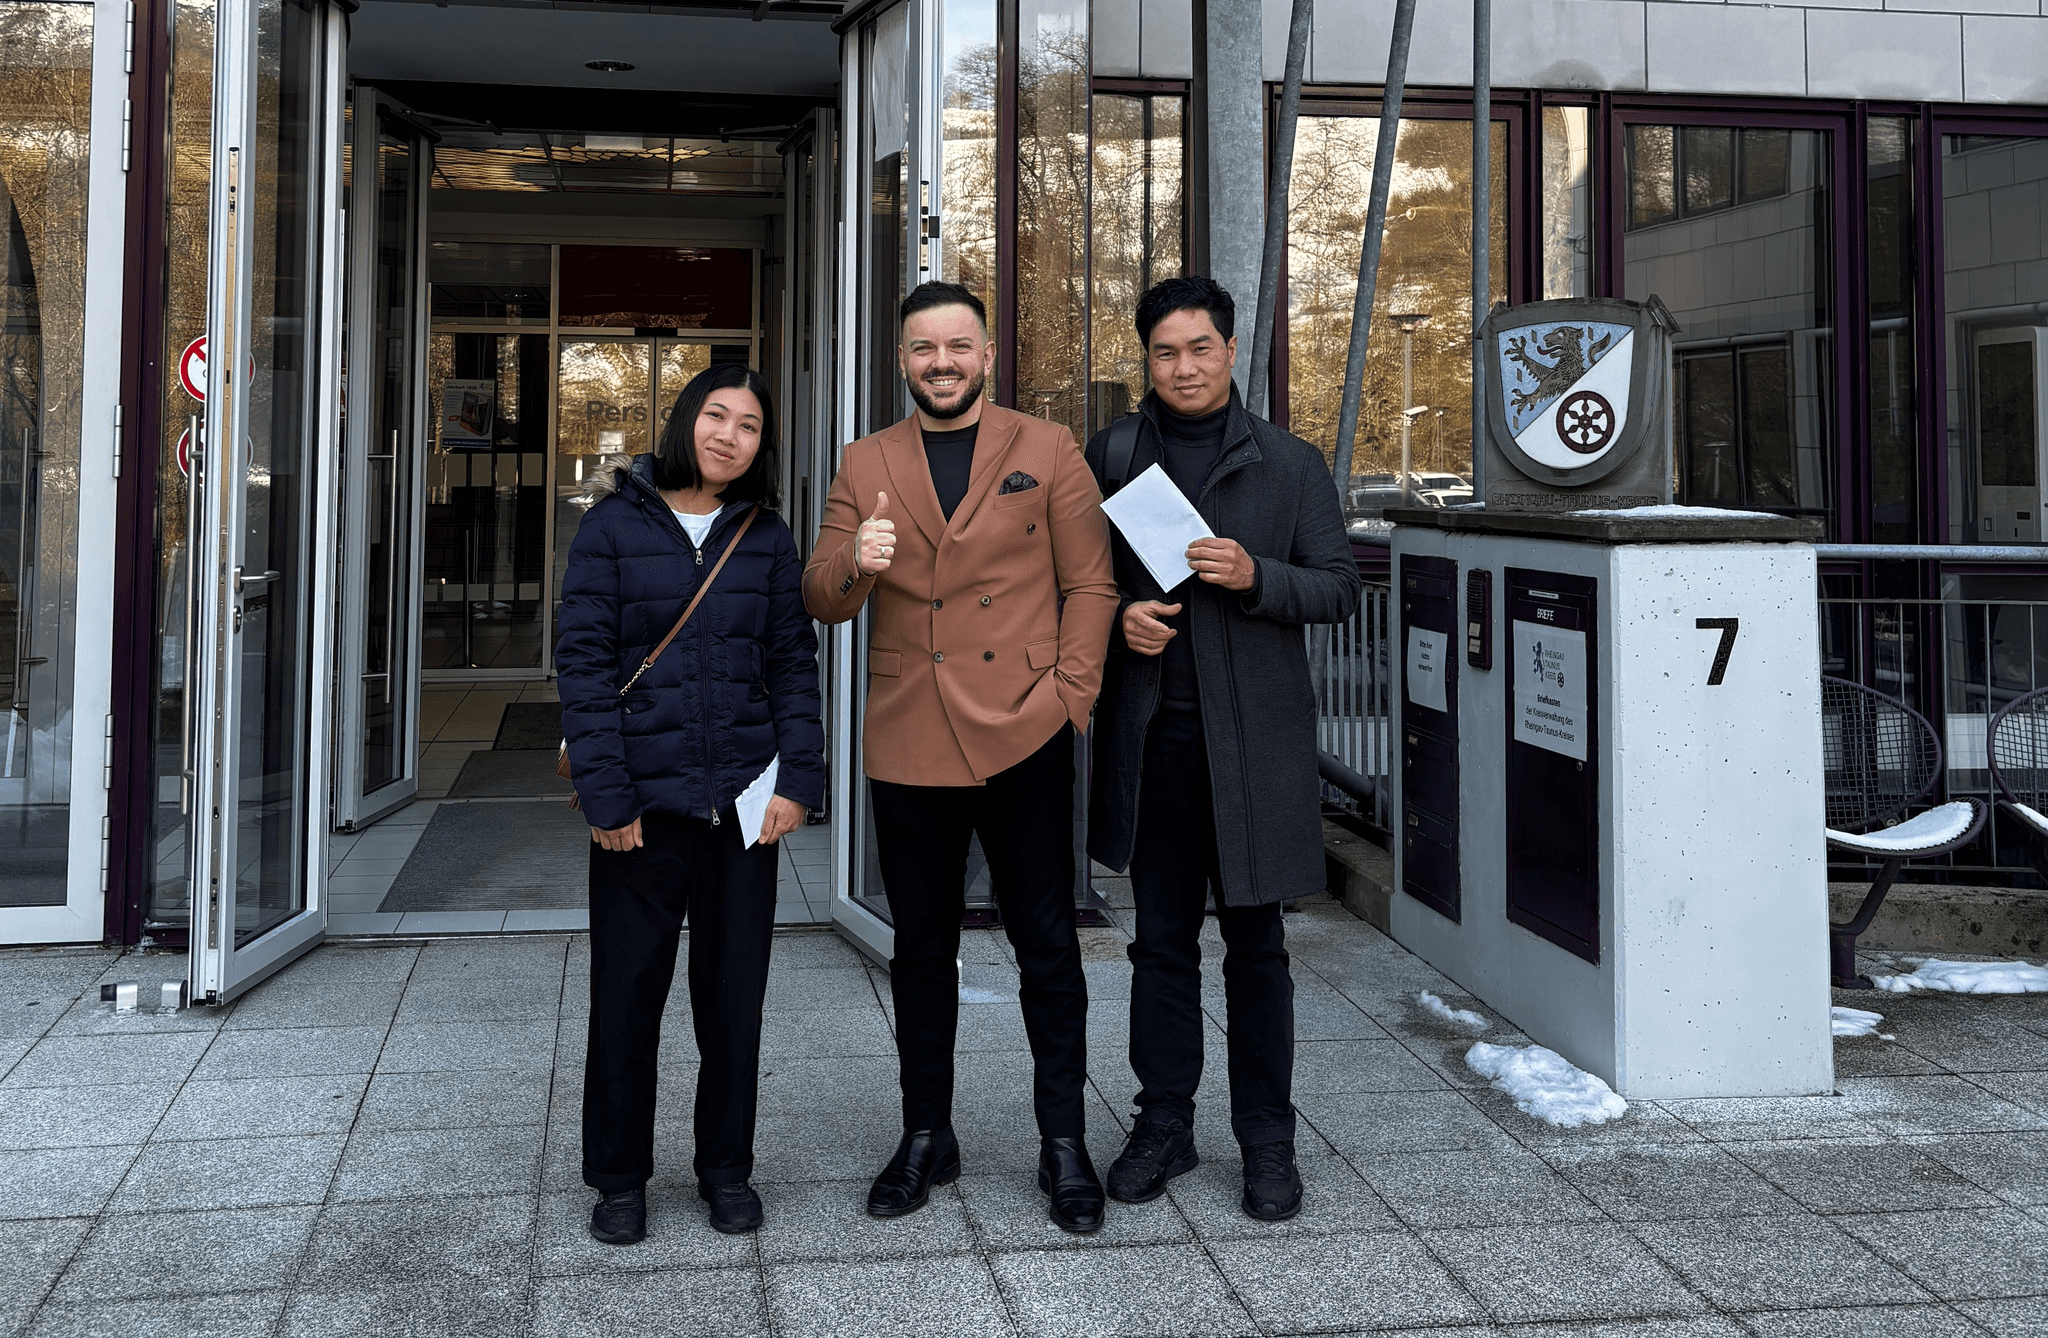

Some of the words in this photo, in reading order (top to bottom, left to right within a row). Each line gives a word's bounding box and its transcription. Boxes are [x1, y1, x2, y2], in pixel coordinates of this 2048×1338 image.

[1536, 608, 1555, 621] BRIEFE
[1544, 649, 1565, 661] RHEINGAU
[1696, 618, 1739, 686] 7
[1544, 660, 1561, 671] TAUNUS
[1544, 670, 1557, 681] KREIS
[1537, 693, 1561, 708] Briefkasten
[1525, 705, 1533, 715] der
[1533, 707, 1565, 726] Kreisverwaltung
[1565, 715, 1573, 726] des
[1524, 719, 1575, 742] Rheingau-Taunus-Kreises
